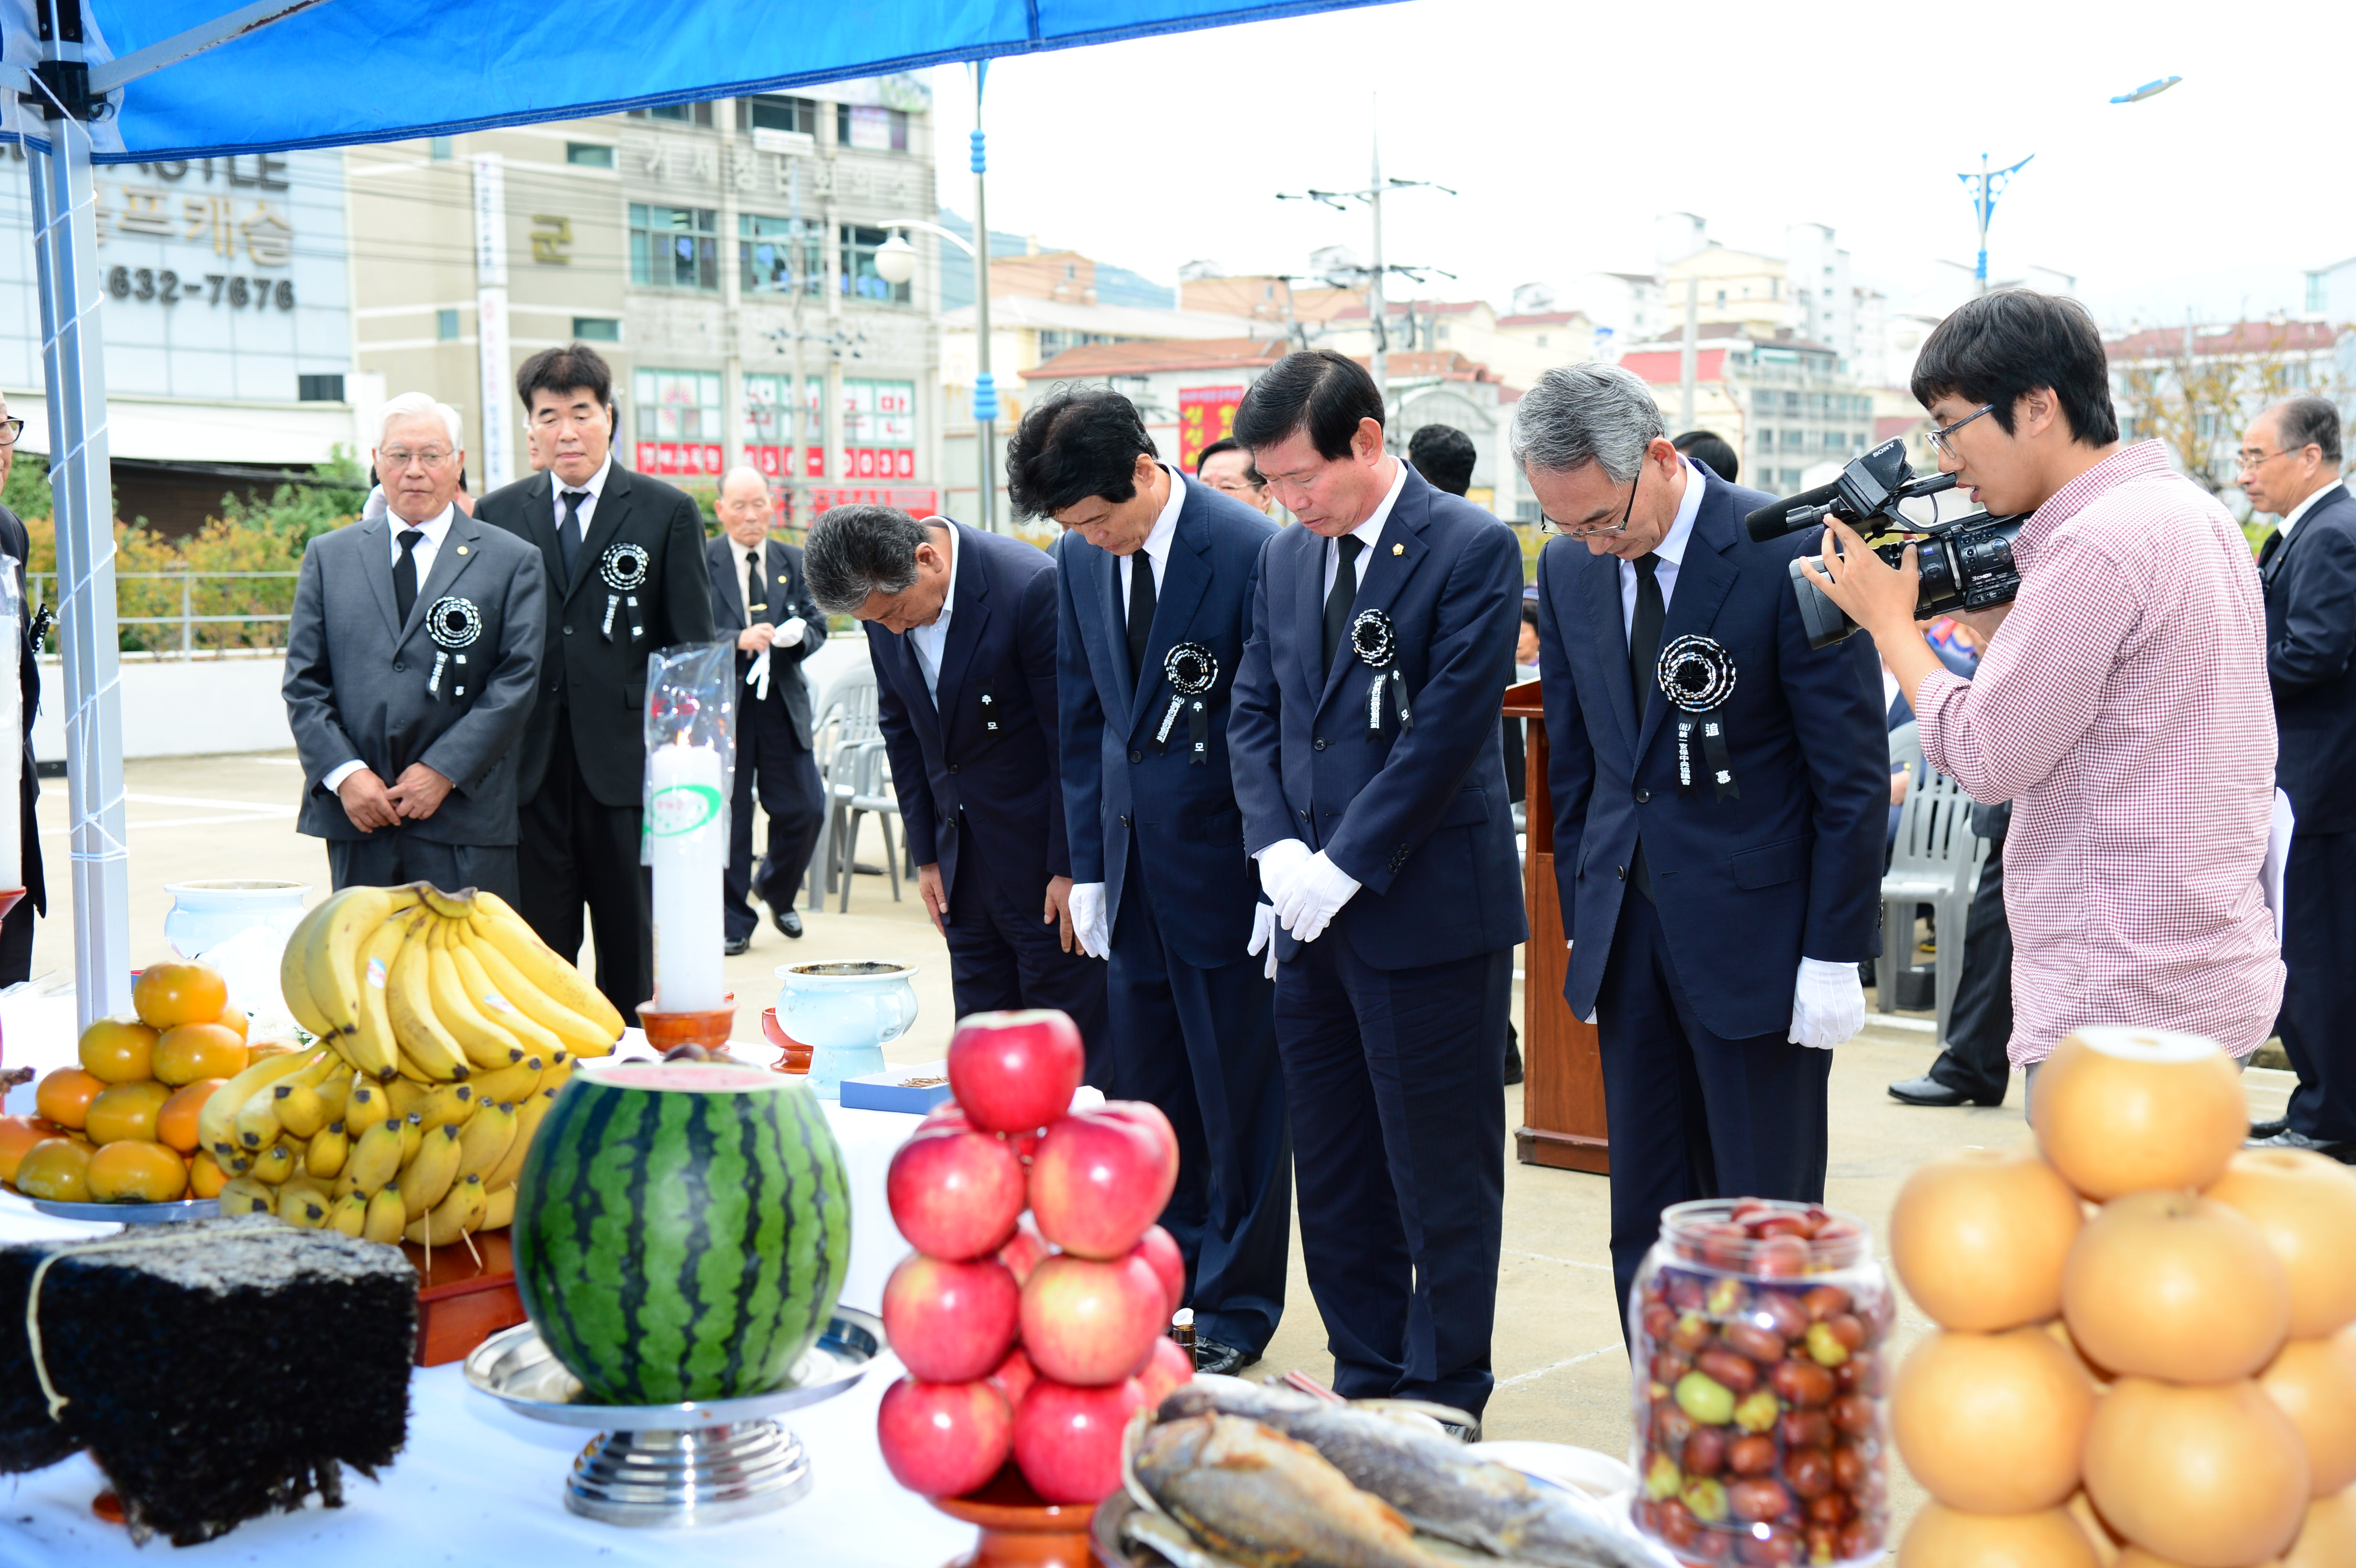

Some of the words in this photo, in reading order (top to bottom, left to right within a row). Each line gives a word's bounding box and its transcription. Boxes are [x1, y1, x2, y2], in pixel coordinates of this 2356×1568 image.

[96, 181, 293, 267] 프캐슬
[529, 214, 573, 266] 군
[1873, 442, 1894, 457] SONY
[1972, 573, 1992, 581] 3CMOS
